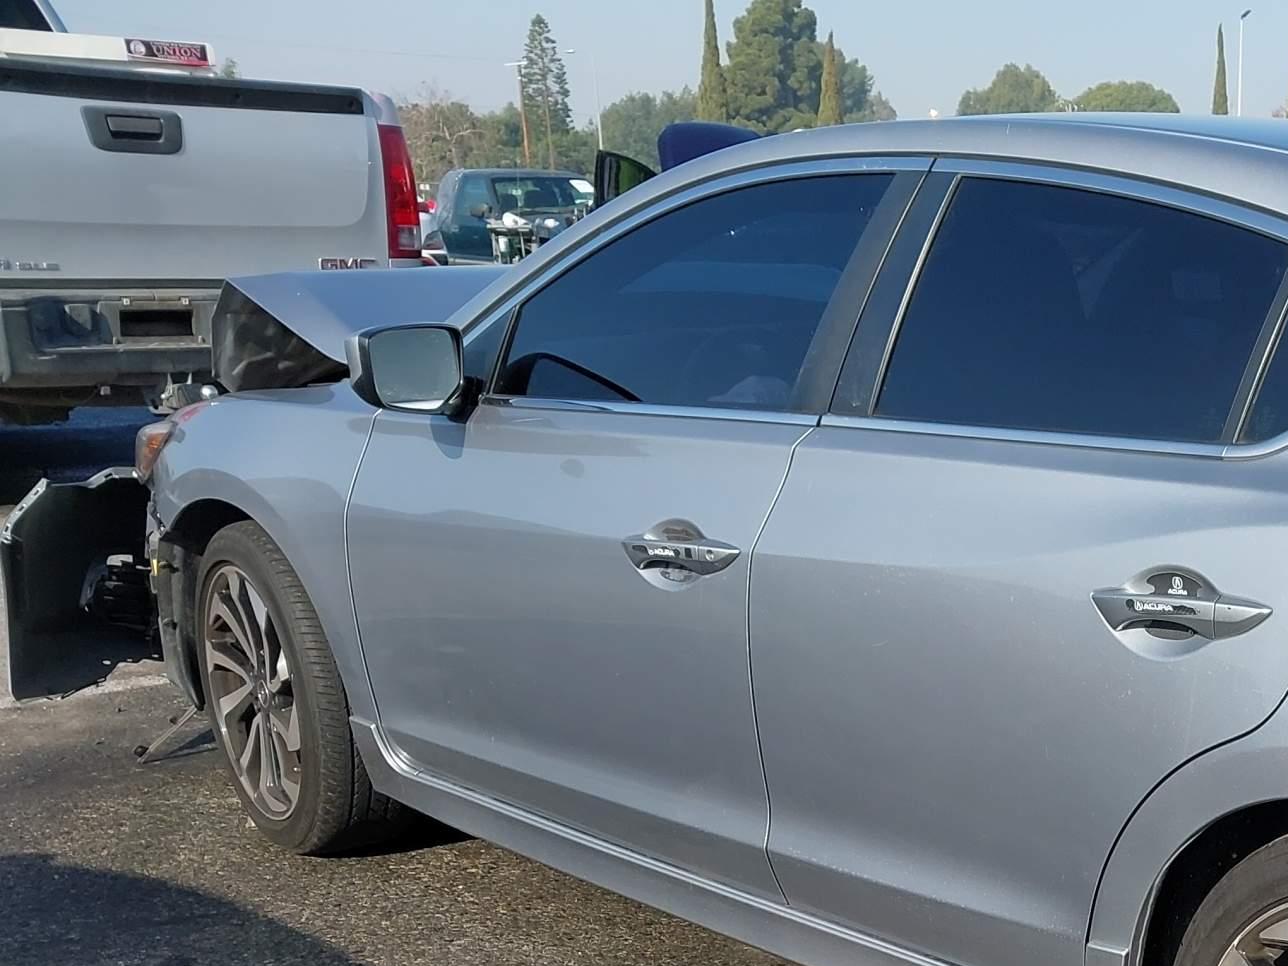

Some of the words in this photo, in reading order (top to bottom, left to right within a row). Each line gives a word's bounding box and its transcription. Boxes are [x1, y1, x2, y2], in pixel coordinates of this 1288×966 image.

[152, 45, 201, 58] UNION
[1168, 588, 1188, 596] ACURA
[1143, 603, 1174, 611] ACURA
